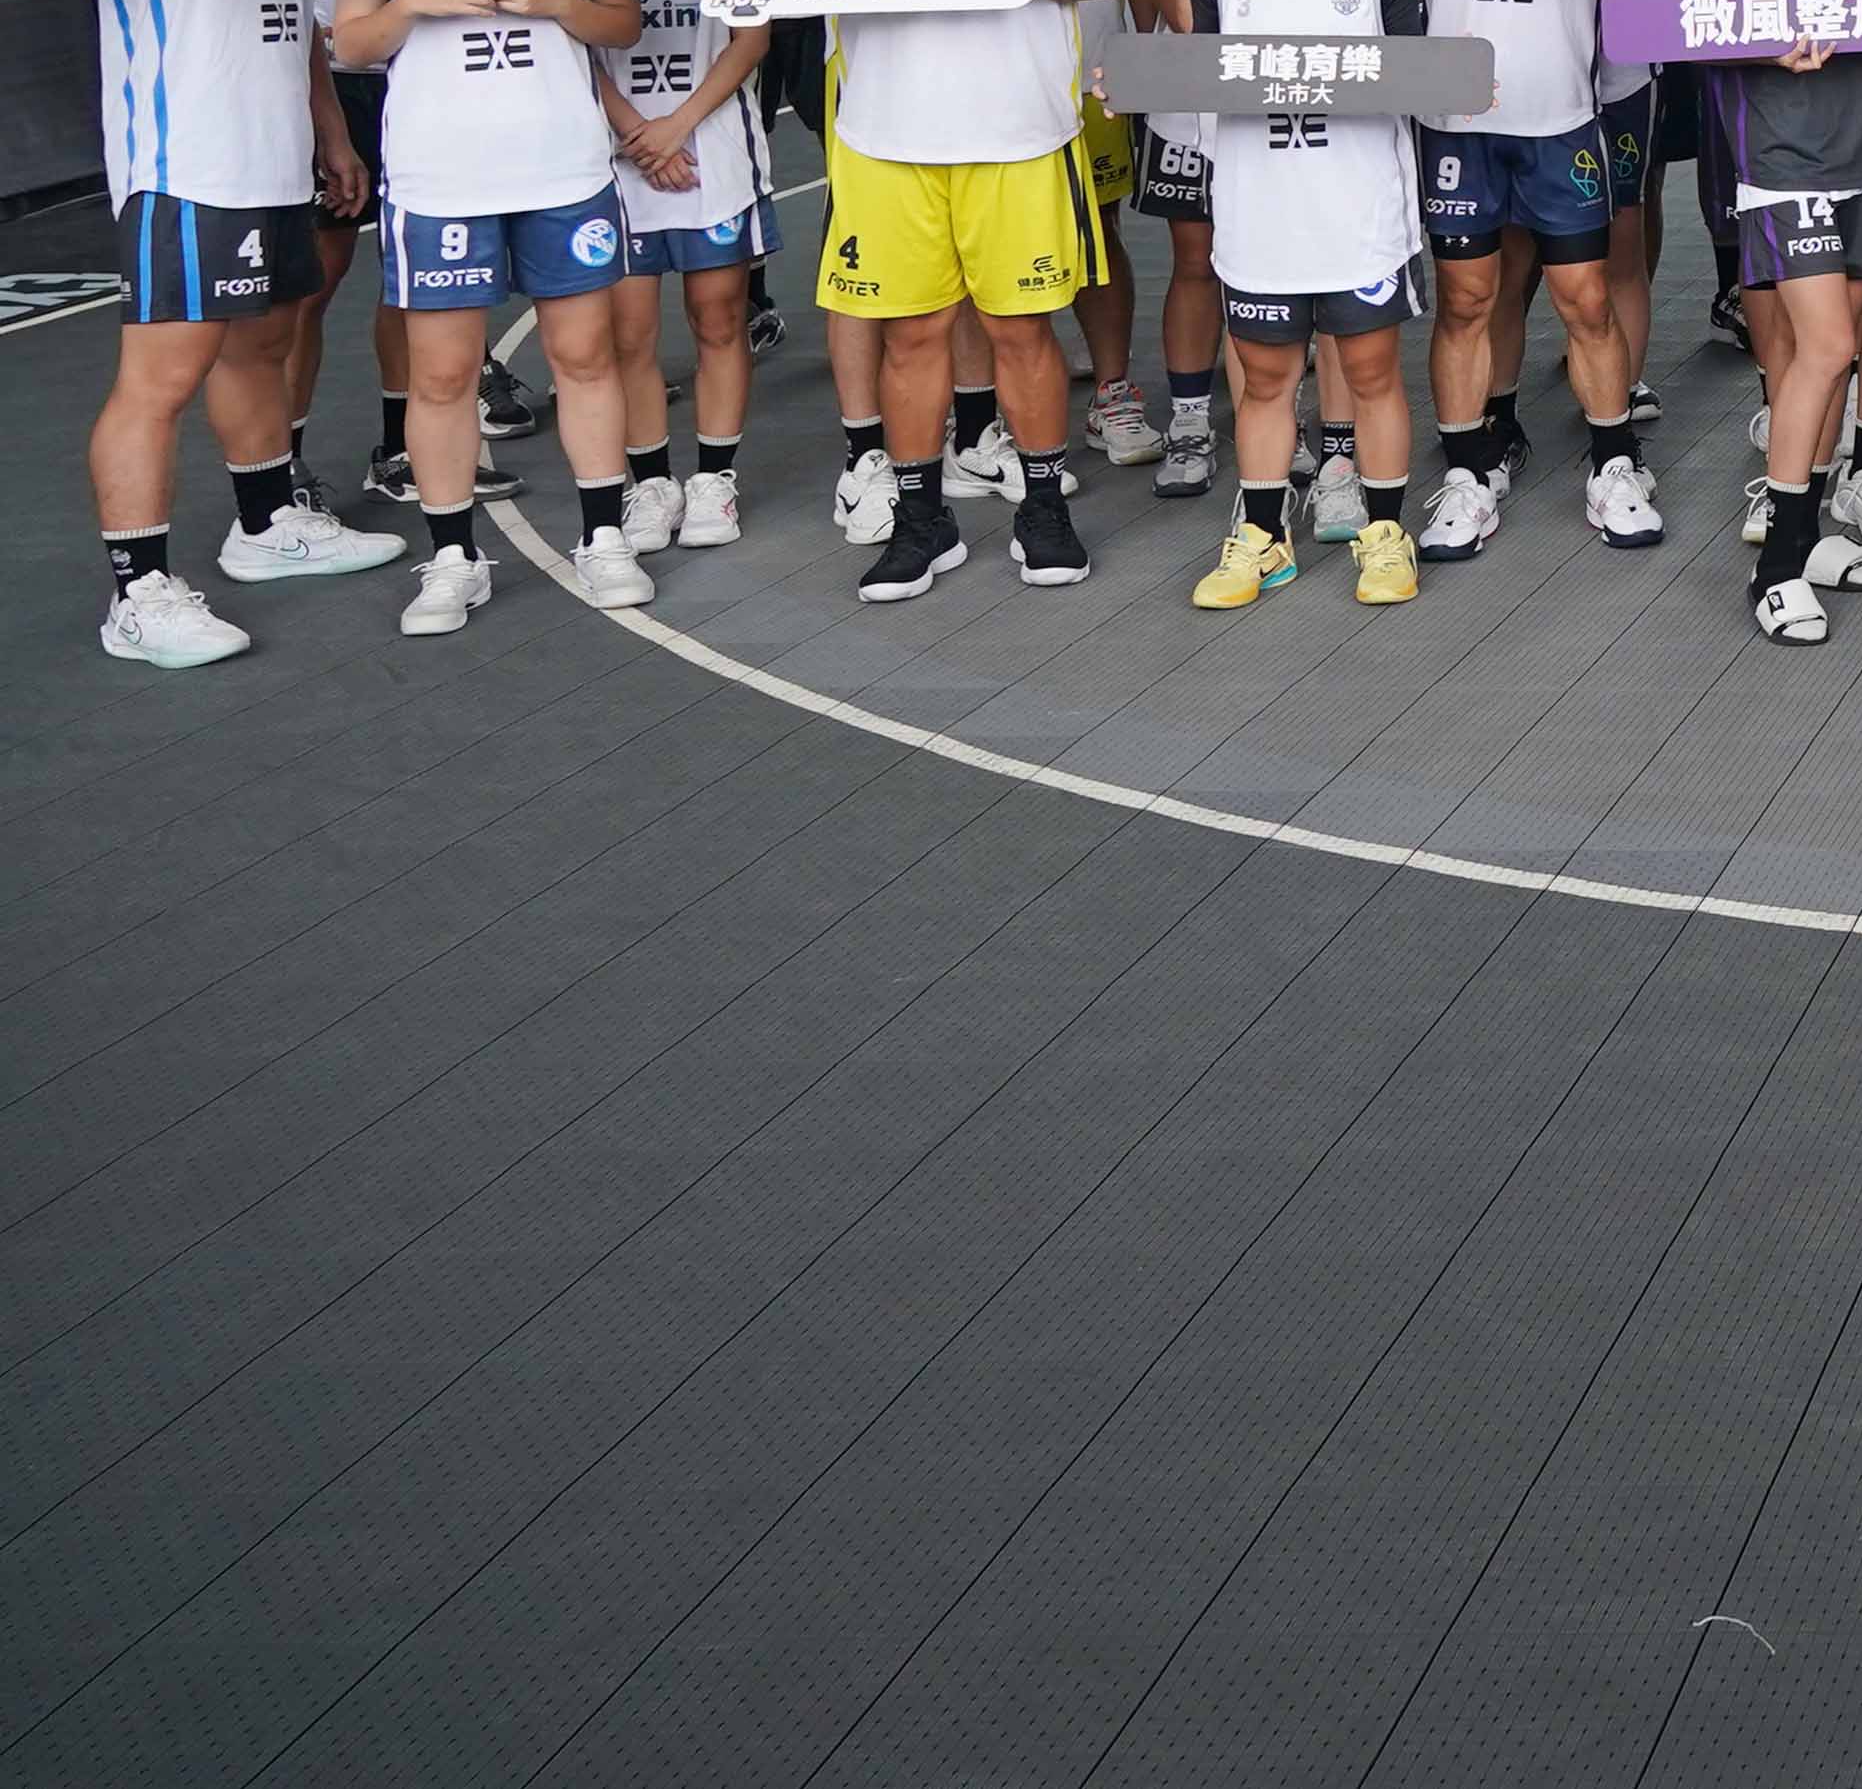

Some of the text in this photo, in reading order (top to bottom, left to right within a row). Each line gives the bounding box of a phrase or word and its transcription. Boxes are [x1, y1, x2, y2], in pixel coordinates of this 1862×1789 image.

[1262, 82, 1334, 107] 北市大
[1159, 141, 1202, 179] 66
[1436, 155, 1462, 191] 9
[238, 228, 265, 269] 4
[439, 223, 470, 262] 9
[837, 235, 861, 270] 4
[413, 267, 494, 289] FOOTER
[1229, 300, 1291, 323] FOOTER
